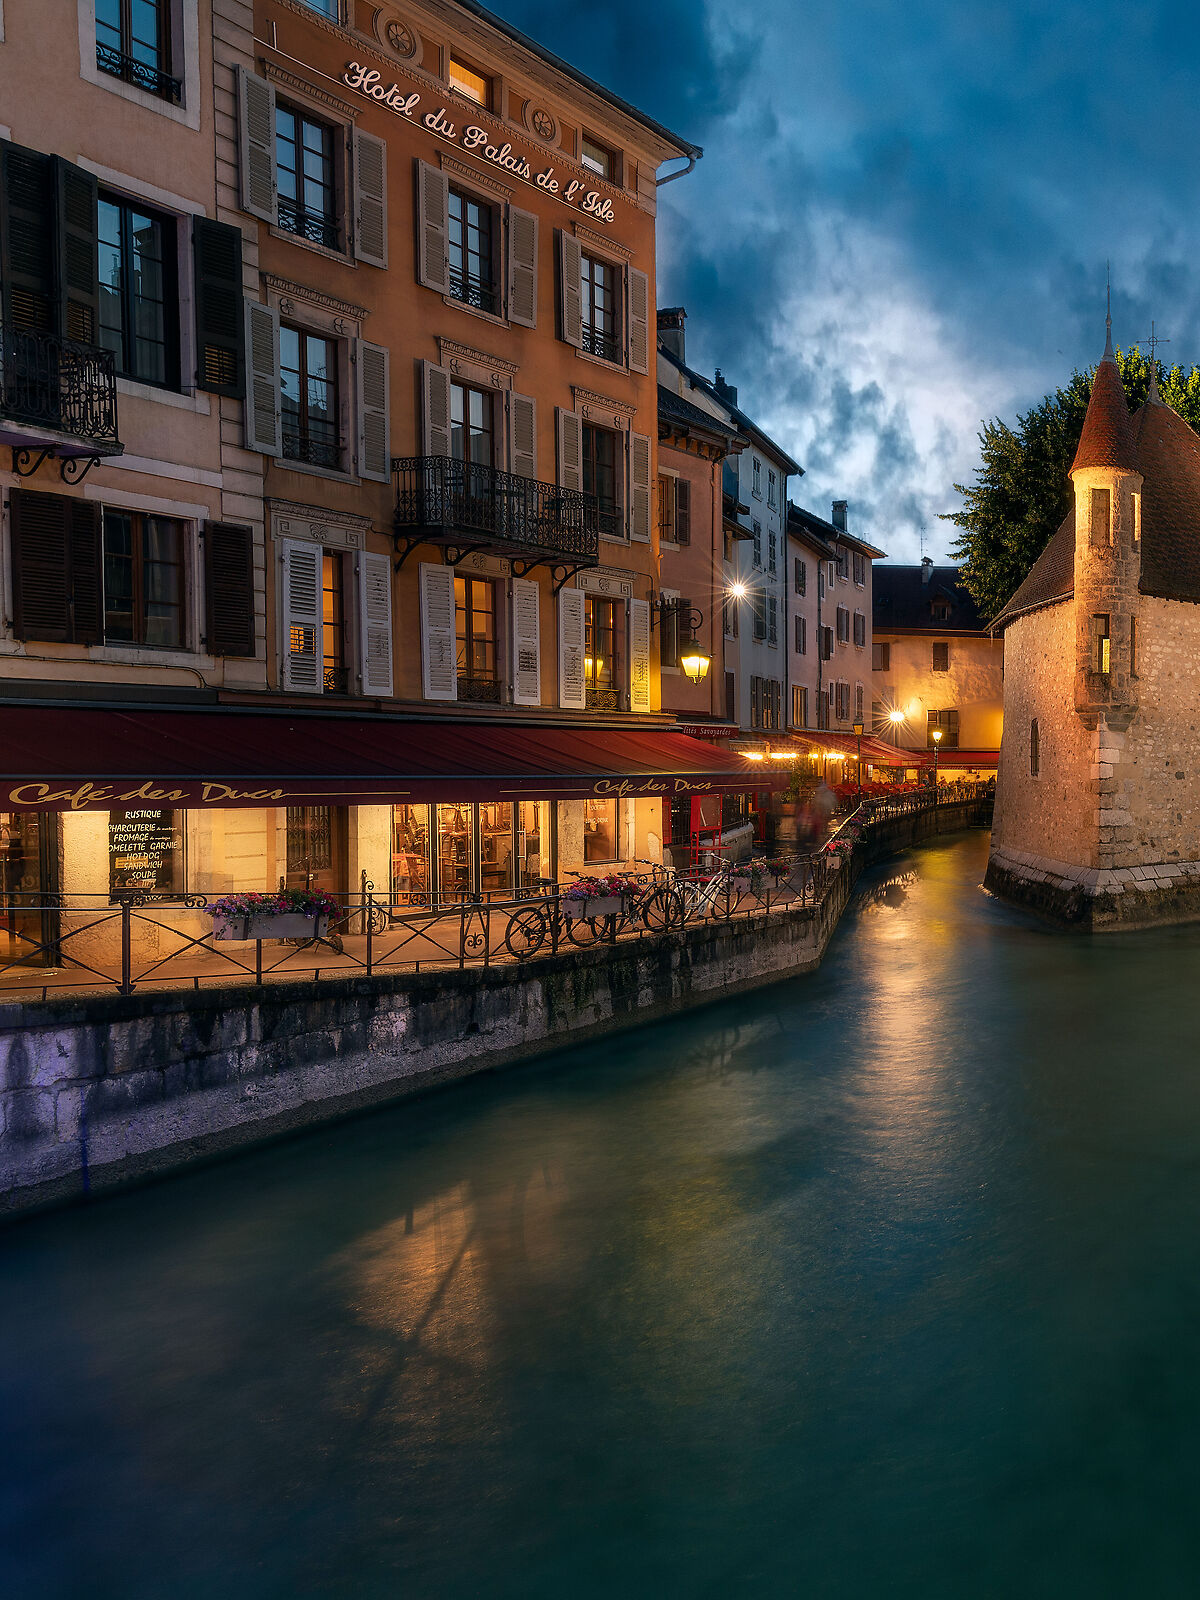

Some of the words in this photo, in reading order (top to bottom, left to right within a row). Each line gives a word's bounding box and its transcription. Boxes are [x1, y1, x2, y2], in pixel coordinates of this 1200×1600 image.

[343, 61, 421, 116] Hotel
[425, 108, 457, 138] du
[463, 124, 530, 179] Palais
[537, 167, 559, 193] de
[582, 190, 615, 223] Isle
[699, 727, 731, 737] Savoyardes
[637, 778, 670, 792] des
[674, 778, 714, 792] Ducs
[8, 781, 116, 809] Café
[118, 780, 192, 801] des
[200, 782, 290, 802] Ducs
[124, 810, 162, 819] RUSTIQUE
[108, 823, 156, 833] CHARCUTERIE
[113, 833, 149, 842] FROMAGE
[109, 843, 146, 852] OMELETTE
[150, 841, 178, 851] GARNIE
[126, 852, 142, 861] HOT
[144, 851, 160, 860] DOG
[123, 860, 163, 871] SANDWICH
[132, 869, 157, 880] SOUPE
